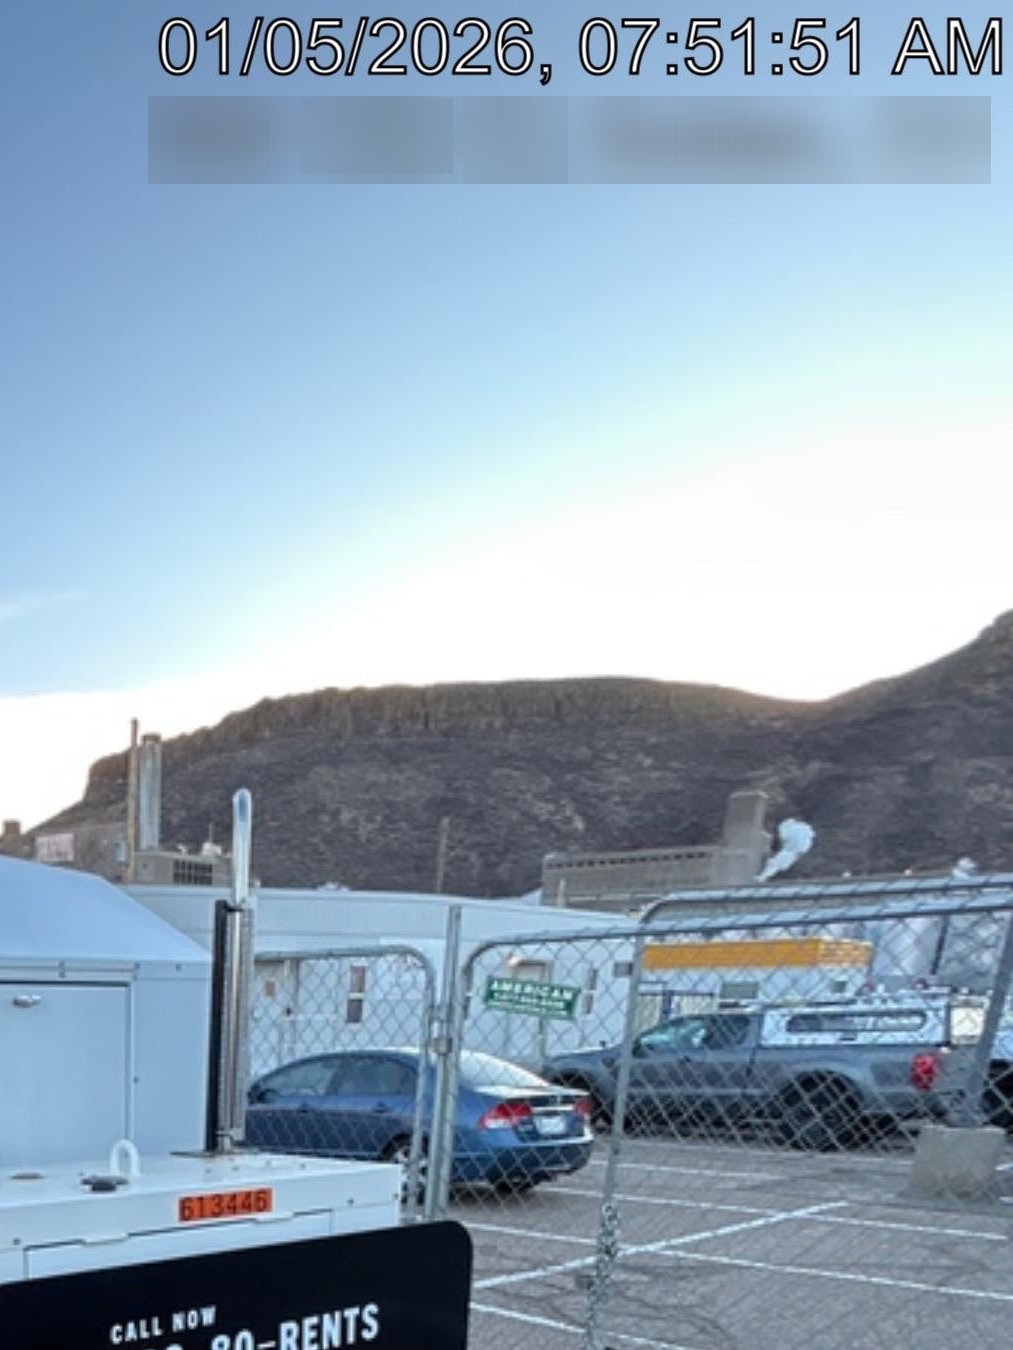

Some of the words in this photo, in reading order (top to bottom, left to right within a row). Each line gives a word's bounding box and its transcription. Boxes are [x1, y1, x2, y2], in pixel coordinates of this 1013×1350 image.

[179, 1188, 269, 1221] 613446
[109, 1316, 164, 1345] CALL
[171, 1304, 217, 1333] NOW
